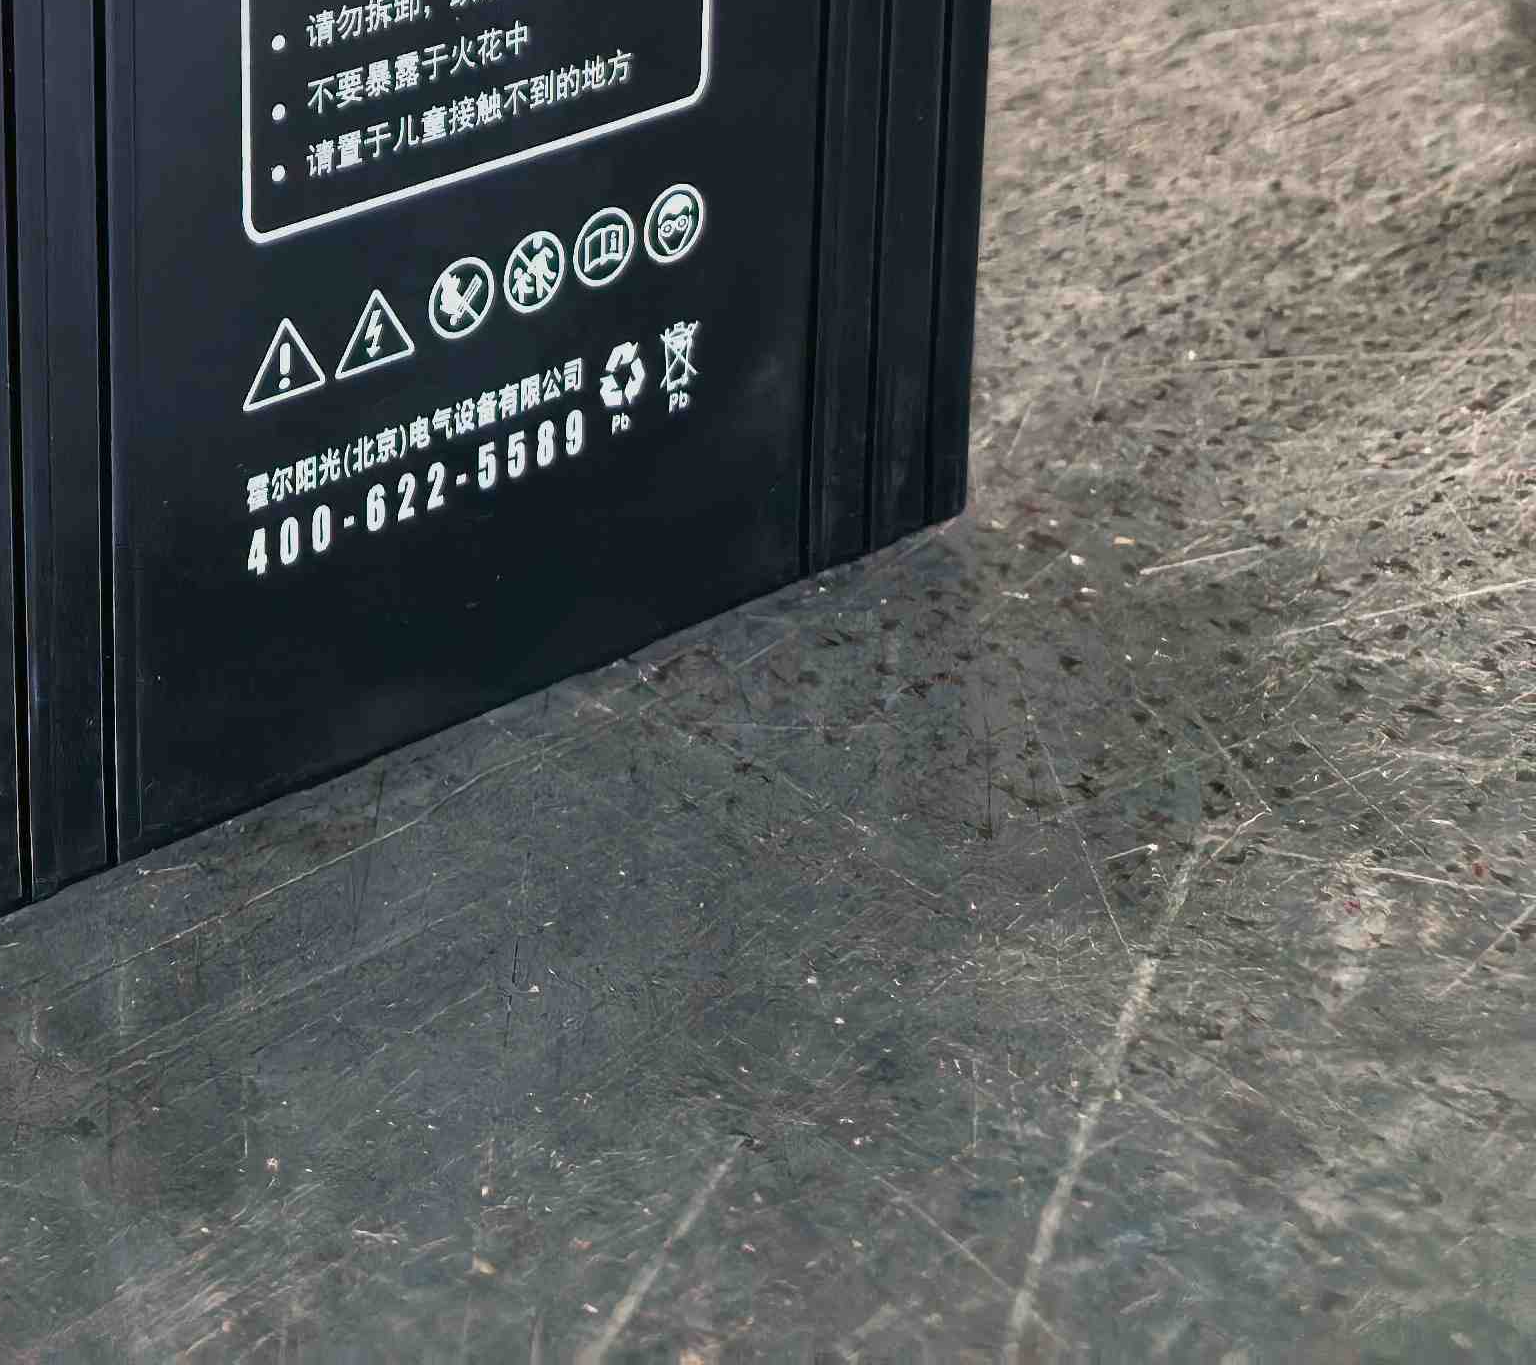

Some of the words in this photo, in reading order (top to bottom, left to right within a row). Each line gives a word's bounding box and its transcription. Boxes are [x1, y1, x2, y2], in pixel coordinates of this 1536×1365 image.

[306, 49, 633, 177] 请置于儿童接触不到的地方
[307, 20, 529, 115] 不要暴露于火花中
[611, 412, 632, 436] Pb
[668, 390, 690, 414] Pb
[247, 408, 583, 576] 400-622-5589
